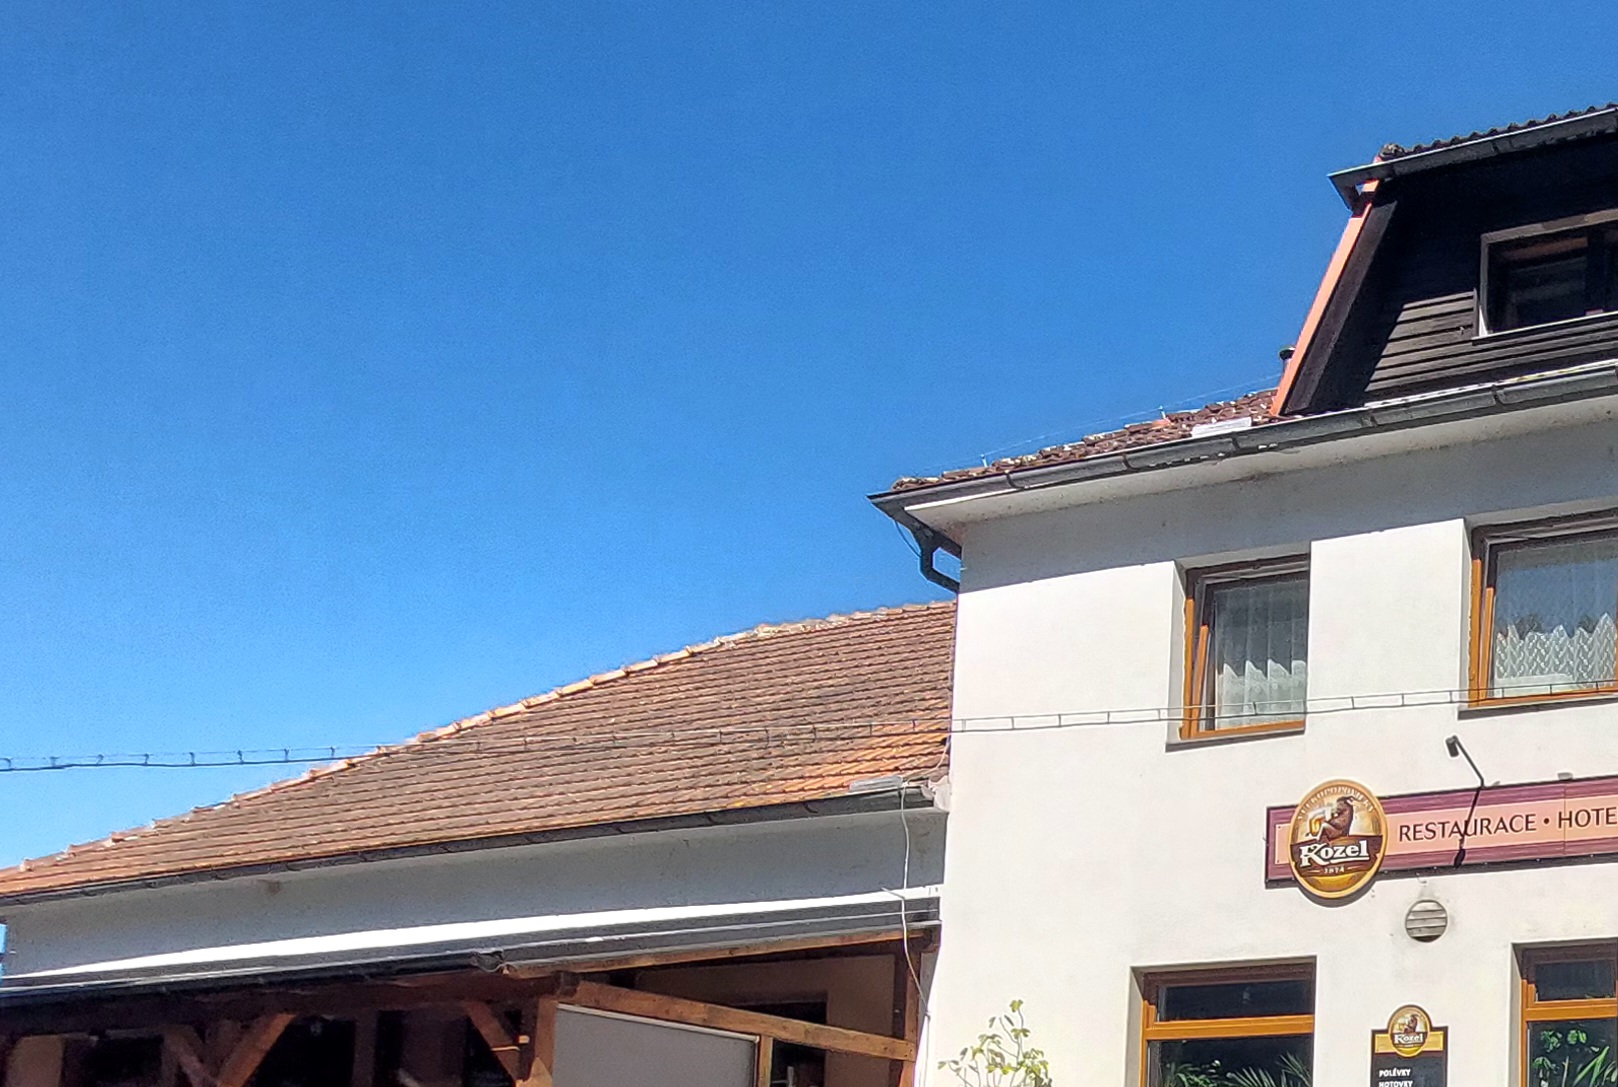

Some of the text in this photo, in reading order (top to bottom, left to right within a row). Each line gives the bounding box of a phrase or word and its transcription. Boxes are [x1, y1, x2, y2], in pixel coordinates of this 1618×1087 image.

[1399, 814, 1537, 842] RESTAURACE
[1299, 840, 1370, 868] Kozel
[1393, 1032, 1424, 1044] Kozel
[1378, 1067, 1412, 1078] POLÉVKY
